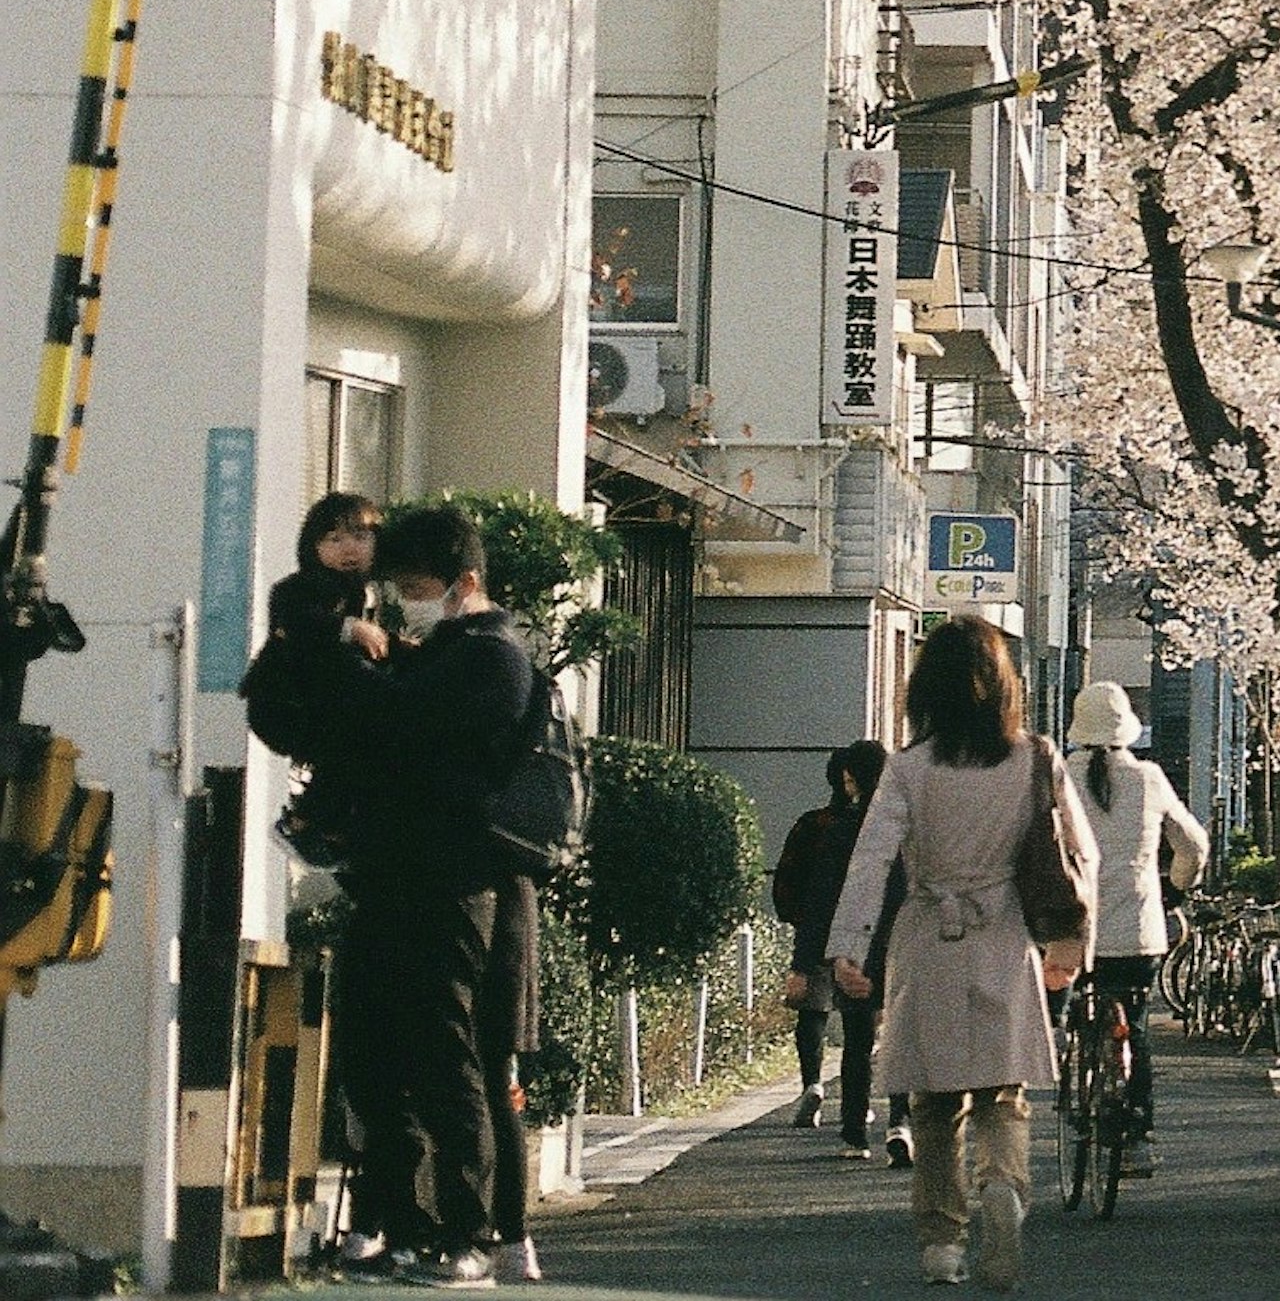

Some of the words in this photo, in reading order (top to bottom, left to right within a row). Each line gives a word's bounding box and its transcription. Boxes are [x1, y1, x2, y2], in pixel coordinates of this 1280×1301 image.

[844, 238, 878, 406] 日本舞踊教室
[948, 522, 987, 568] P
[964, 553, 995, 567] 24h
